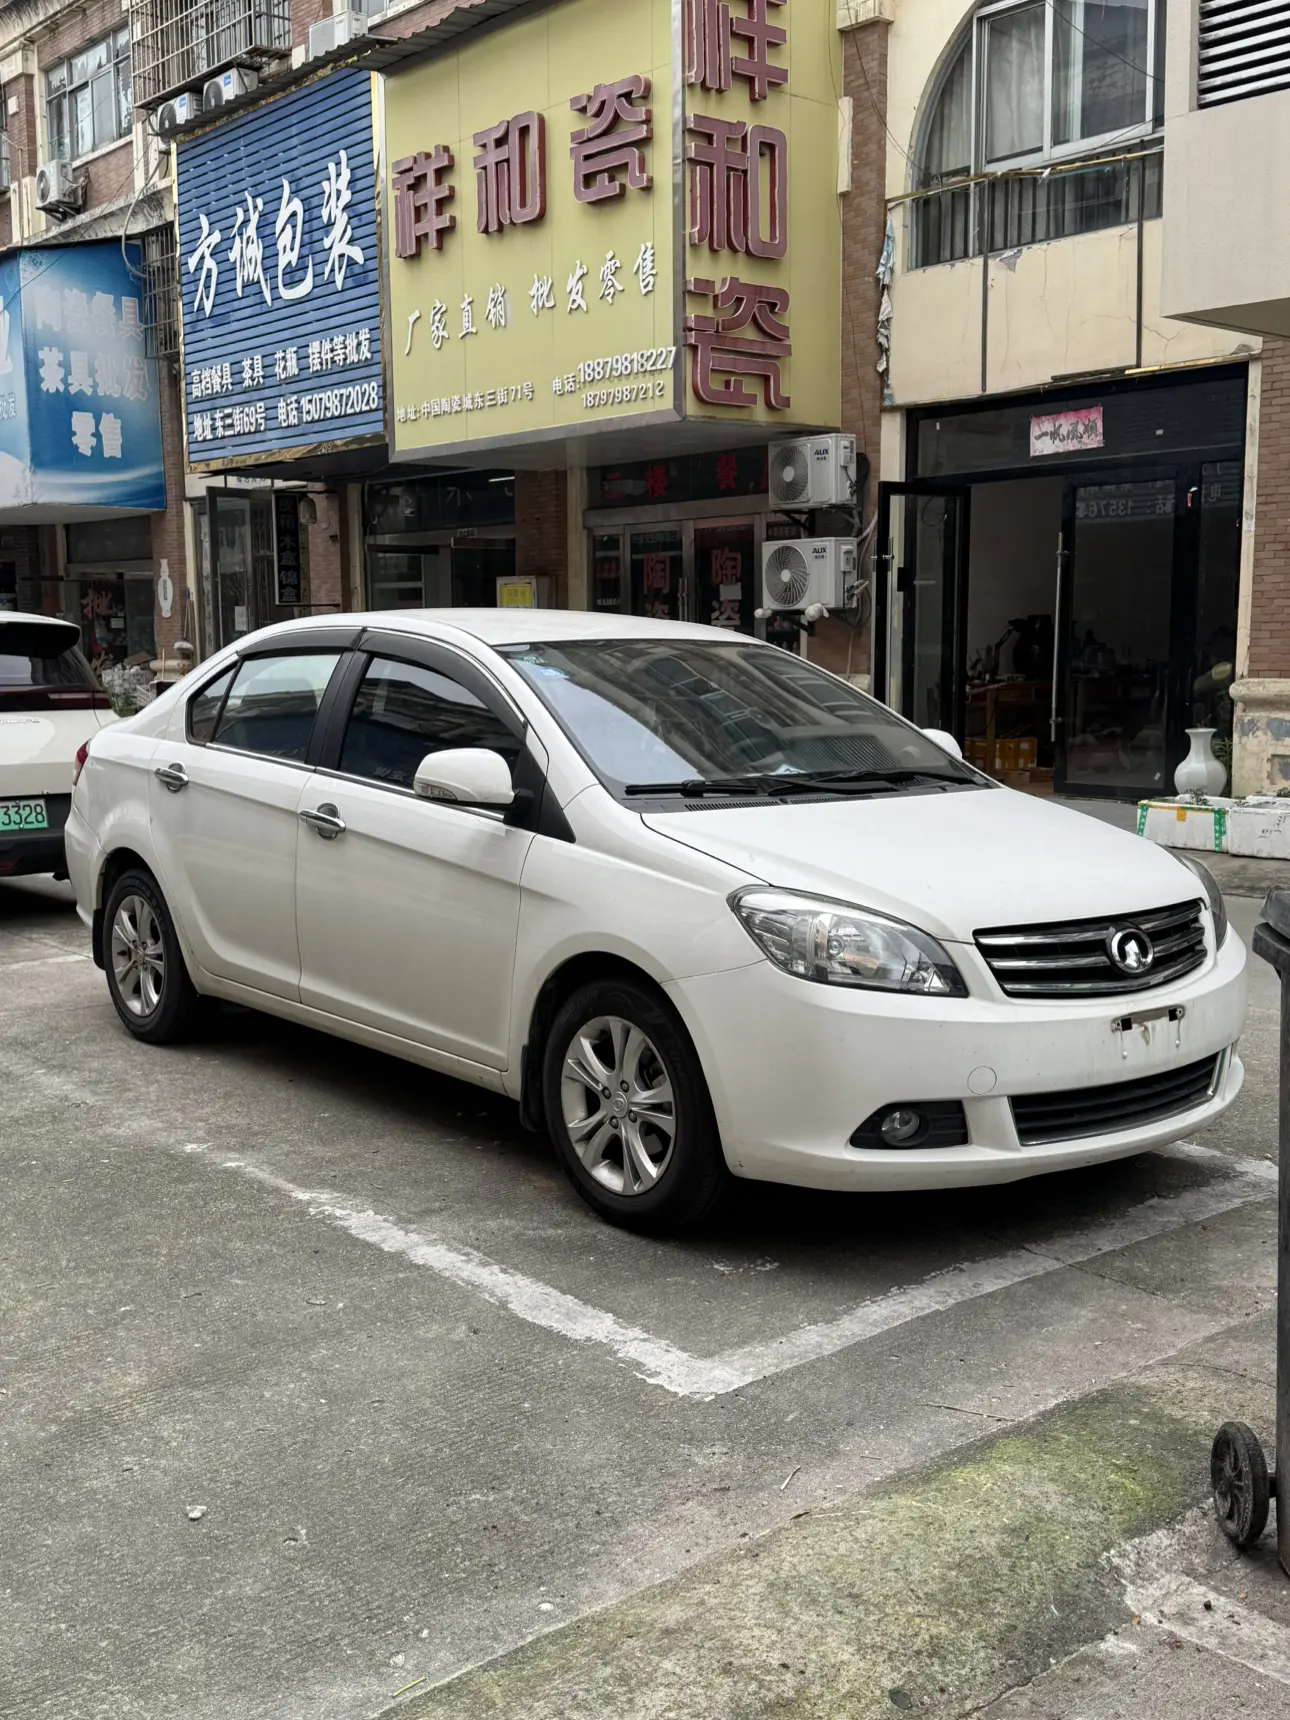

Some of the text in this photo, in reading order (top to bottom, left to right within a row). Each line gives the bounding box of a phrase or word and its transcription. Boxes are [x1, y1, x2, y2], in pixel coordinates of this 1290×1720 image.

[391, 74, 653, 259] 祥和瓷
[187, 149, 365, 318] 方诚包装
[404, 241, 657, 356] 厂家直销 批发零售
[38, 346, 148, 402] 茶具批发
[190, 328, 372, 398] 高档餐具 茶具 花瓶 摆件等批发
[71, 411, 123, 458] 零售
[814, 448, 829, 456] AUX
